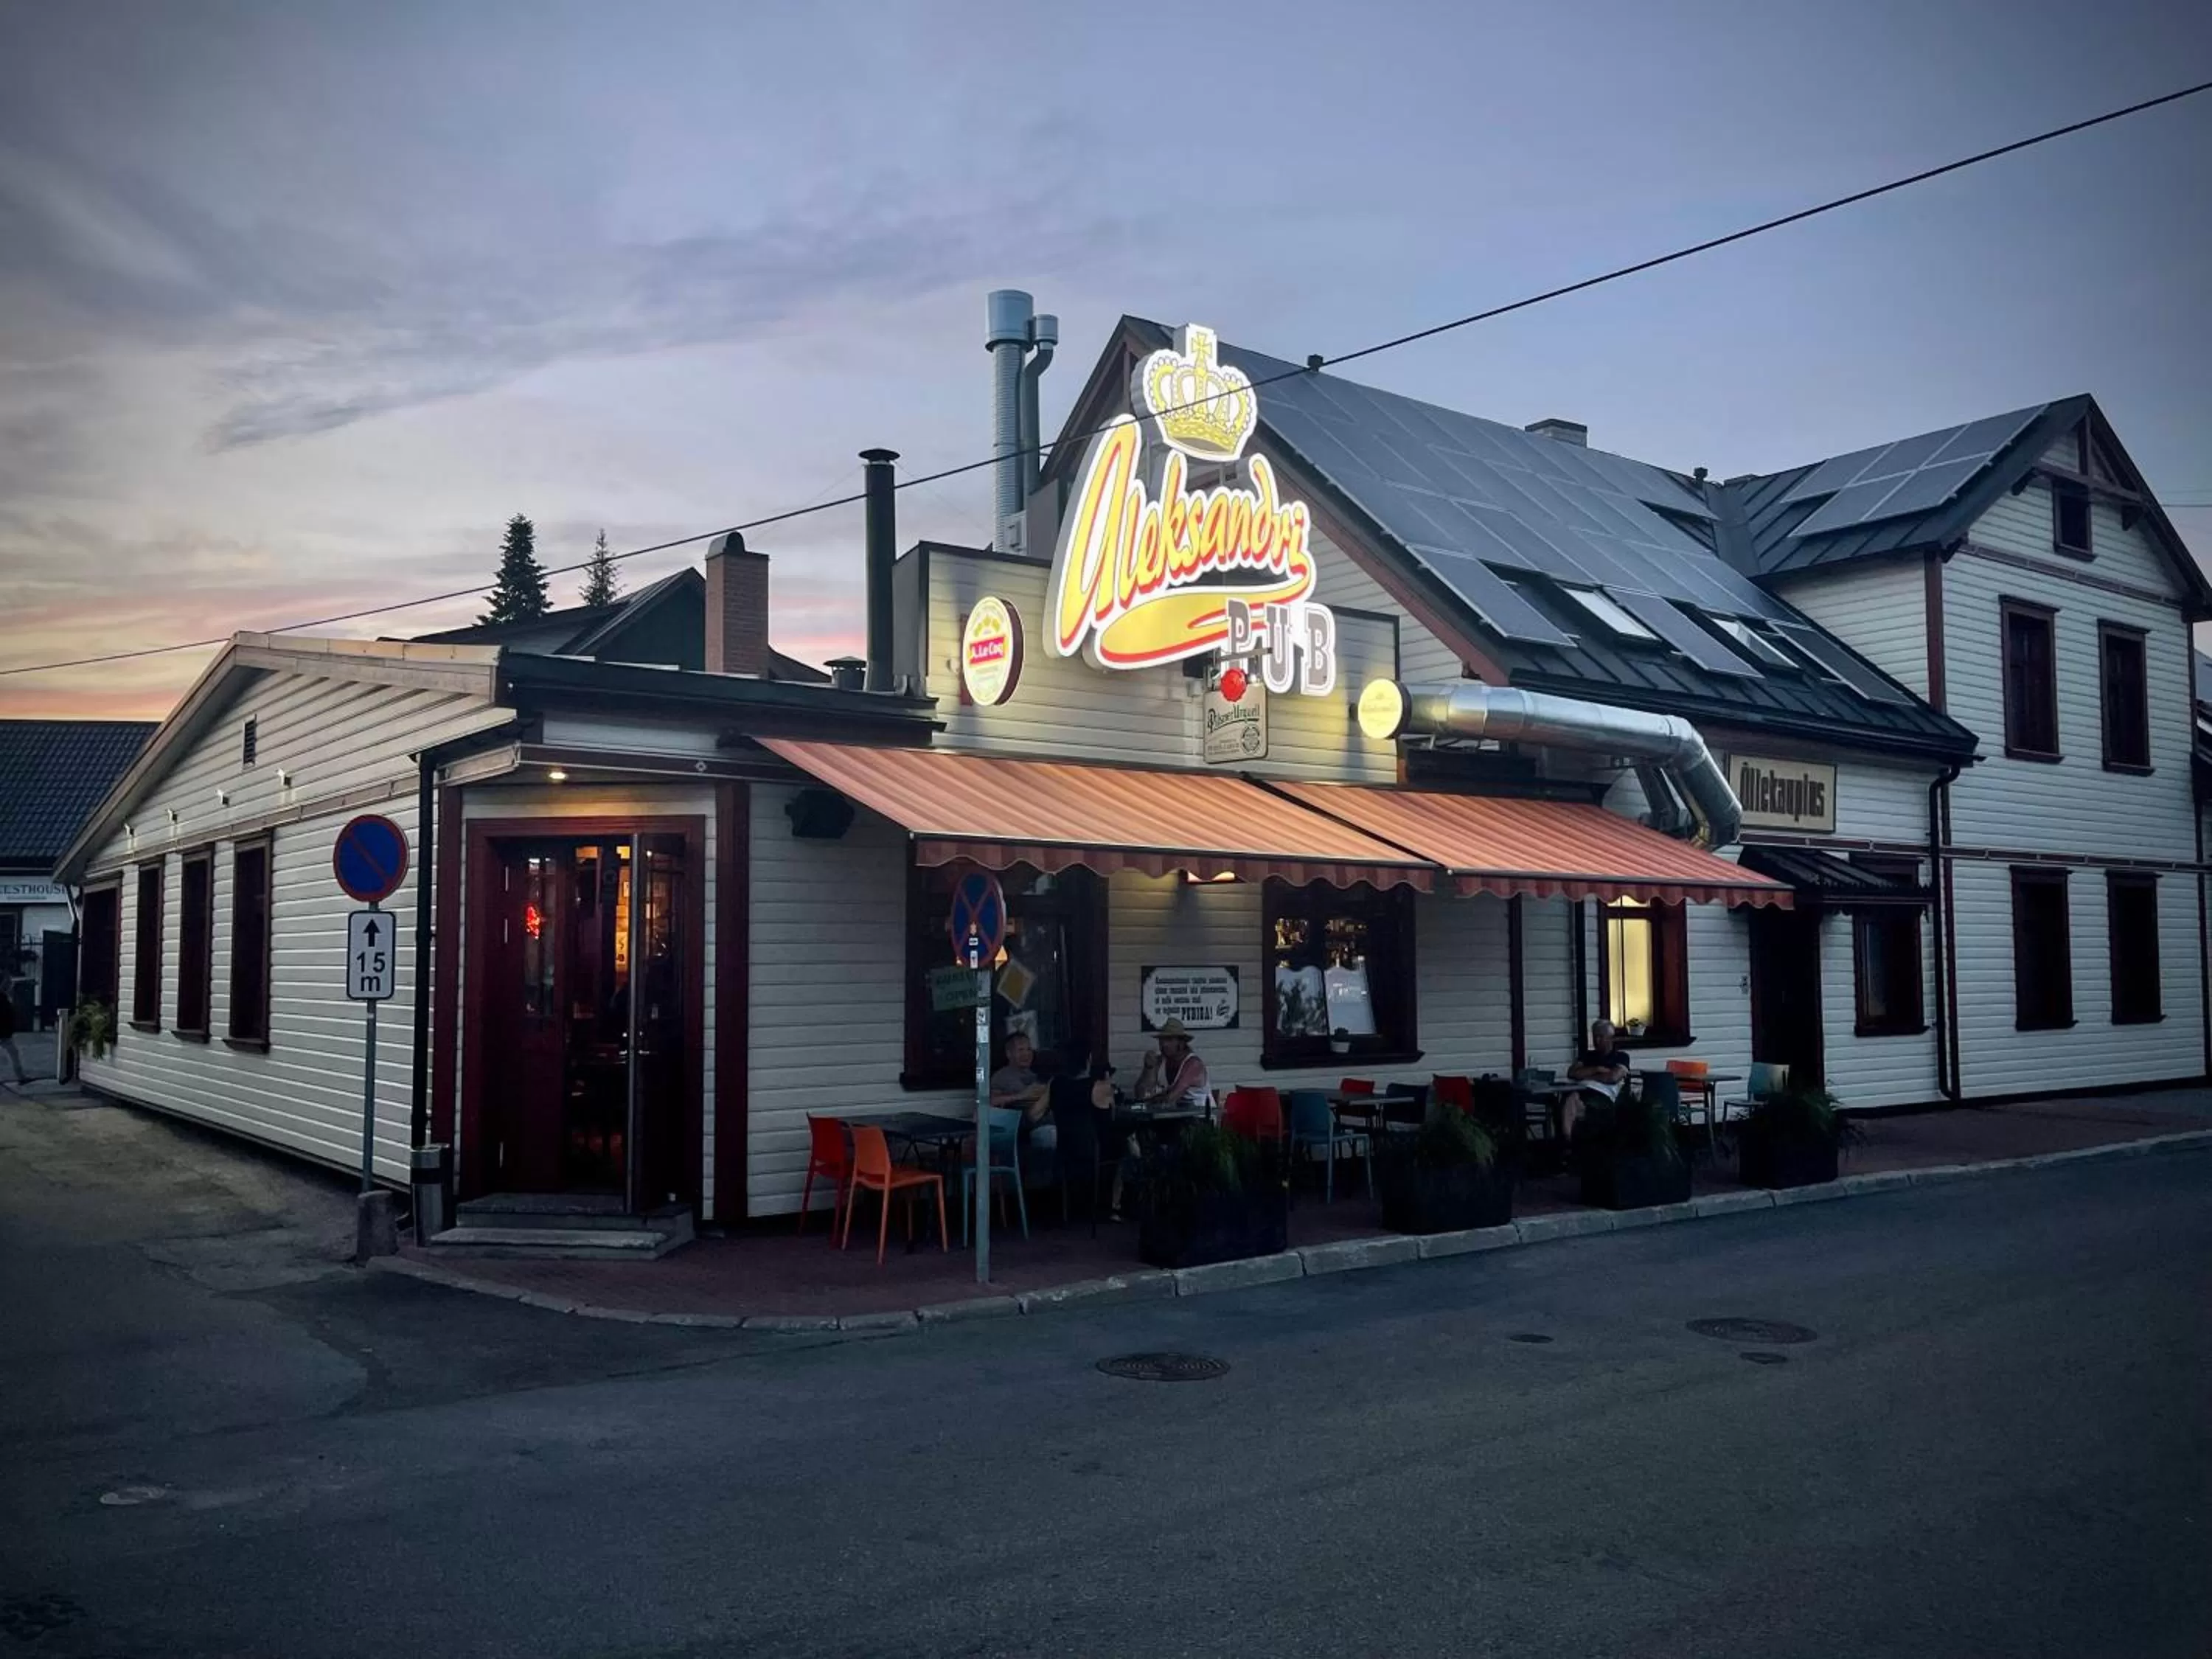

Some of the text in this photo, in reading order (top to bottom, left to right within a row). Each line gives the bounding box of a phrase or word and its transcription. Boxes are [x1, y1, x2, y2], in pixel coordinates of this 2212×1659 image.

[1060, 418, 1311, 649] Aleksandri
[1226, 599, 1335, 694] PUB
[356, 951, 386, 973] 15
[361, 975, 380, 992] m
